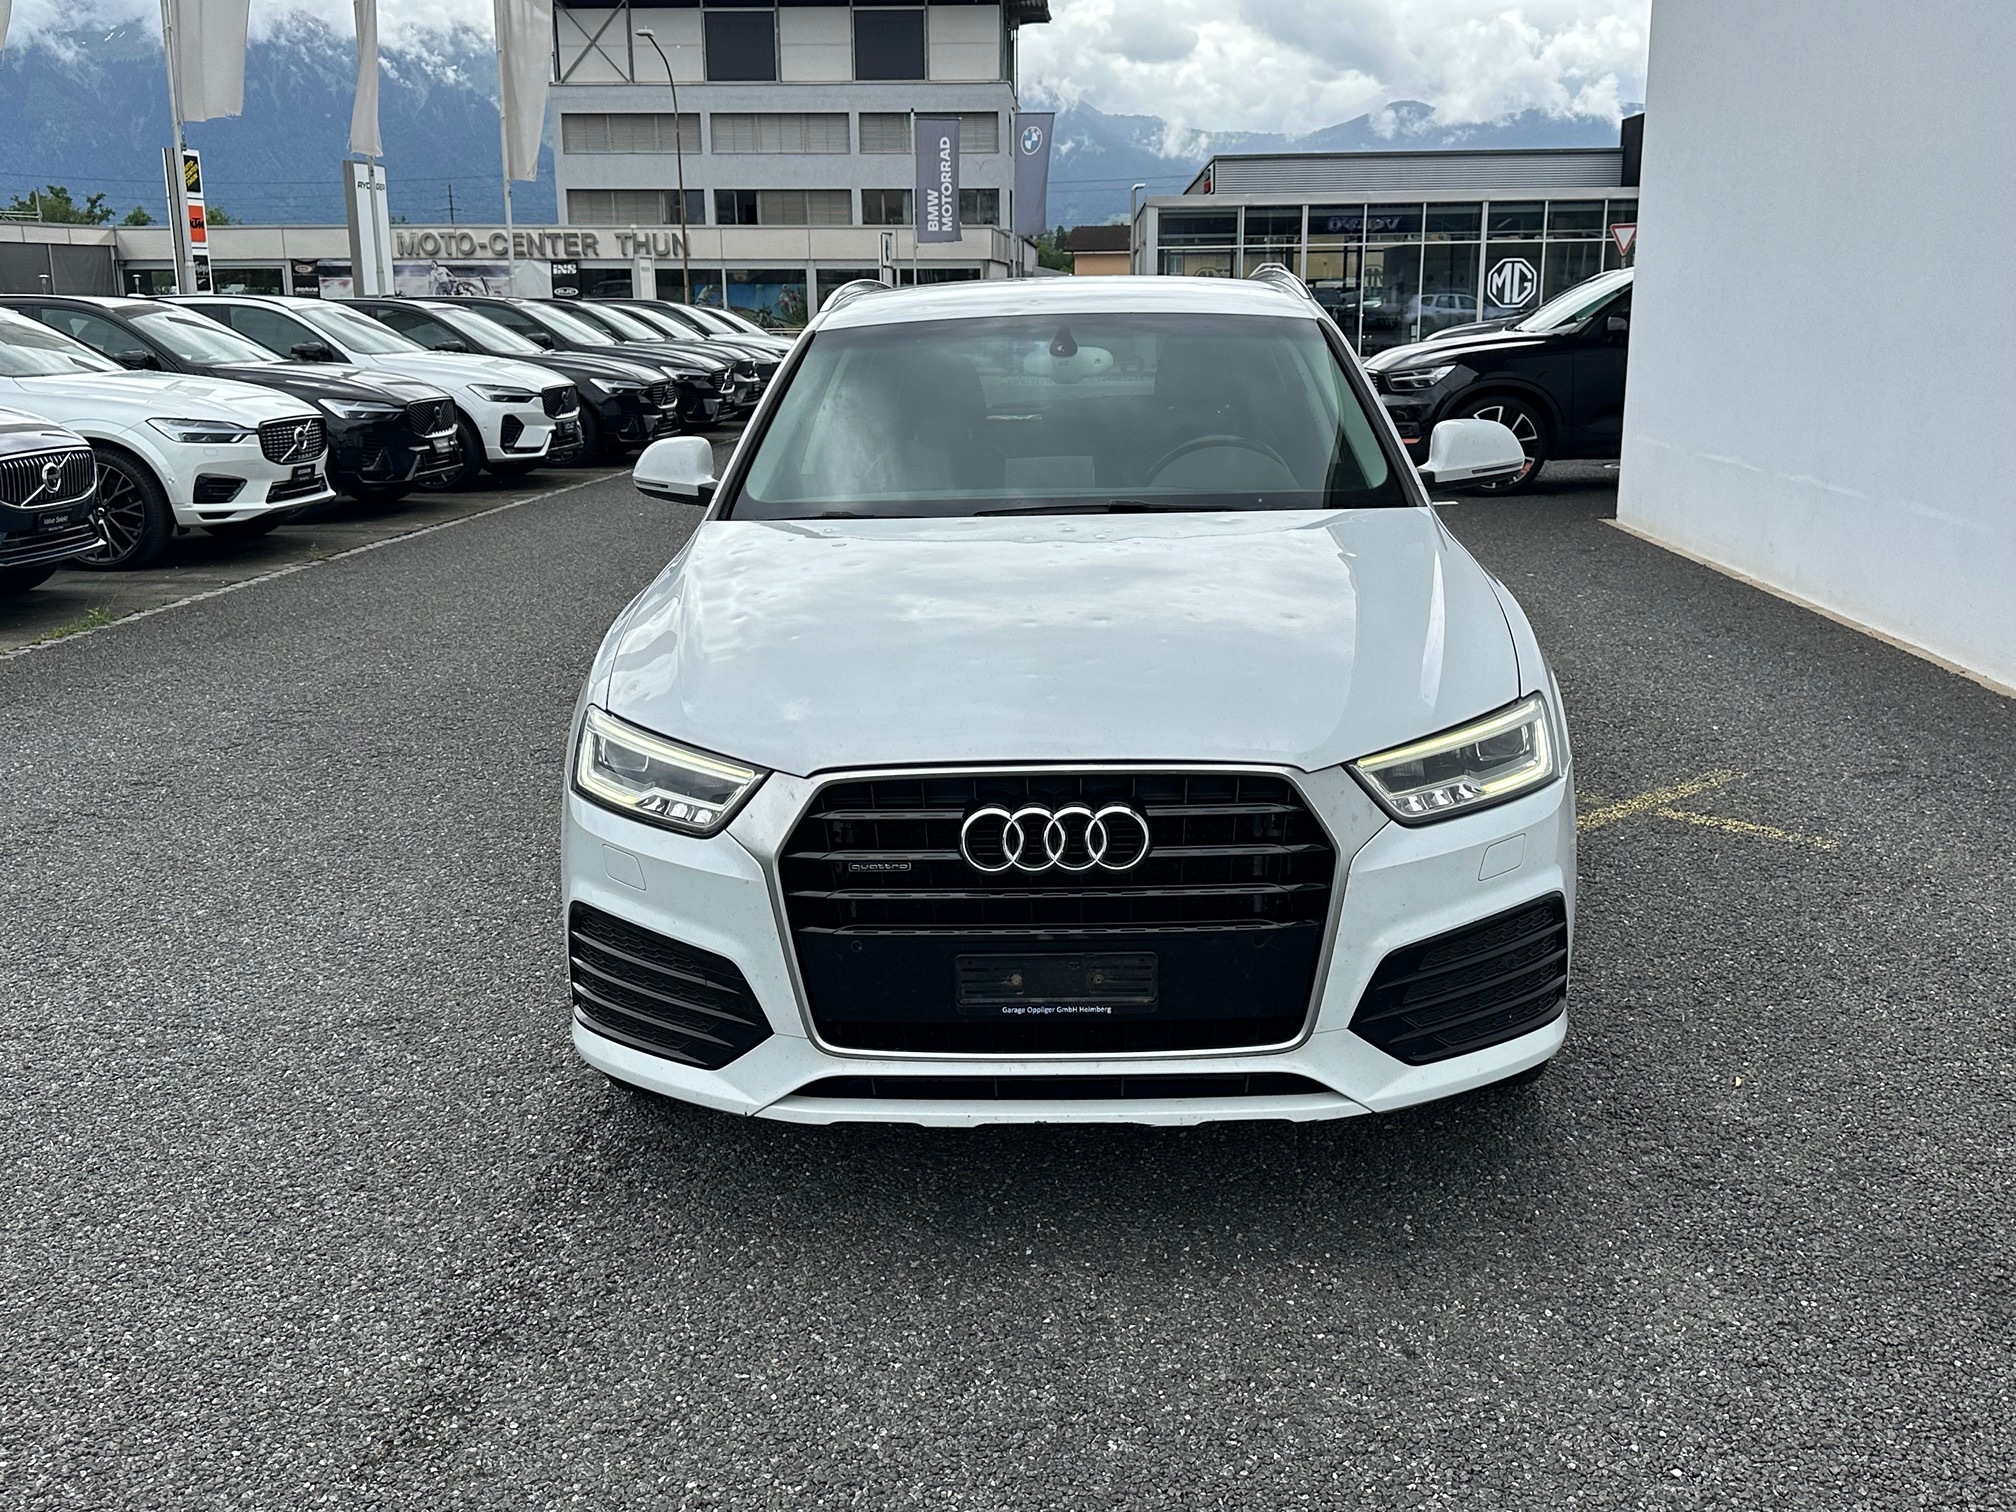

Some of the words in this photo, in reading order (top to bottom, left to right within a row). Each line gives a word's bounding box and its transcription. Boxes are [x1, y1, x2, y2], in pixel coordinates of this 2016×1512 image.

[939, 136, 953, 232] MOTORRAD
[189, 217, 205, 230] KTM
[926, 189, 939, 232] BMW
[395, 231, 599, 257] MOTO-CENTER
[614, 231, 691, 257] THUN
[1490, 262, 1534, 304] MG
[851, 863, 908, 871] quattro
[1002, 1006, 1026, 1015] Garage
[1027, 1006, 1056, 1015] Oppliger
[1056, 1006, 1078, 1014] GmbH
[1079, 1006, 1112, 1015] Heimberg
